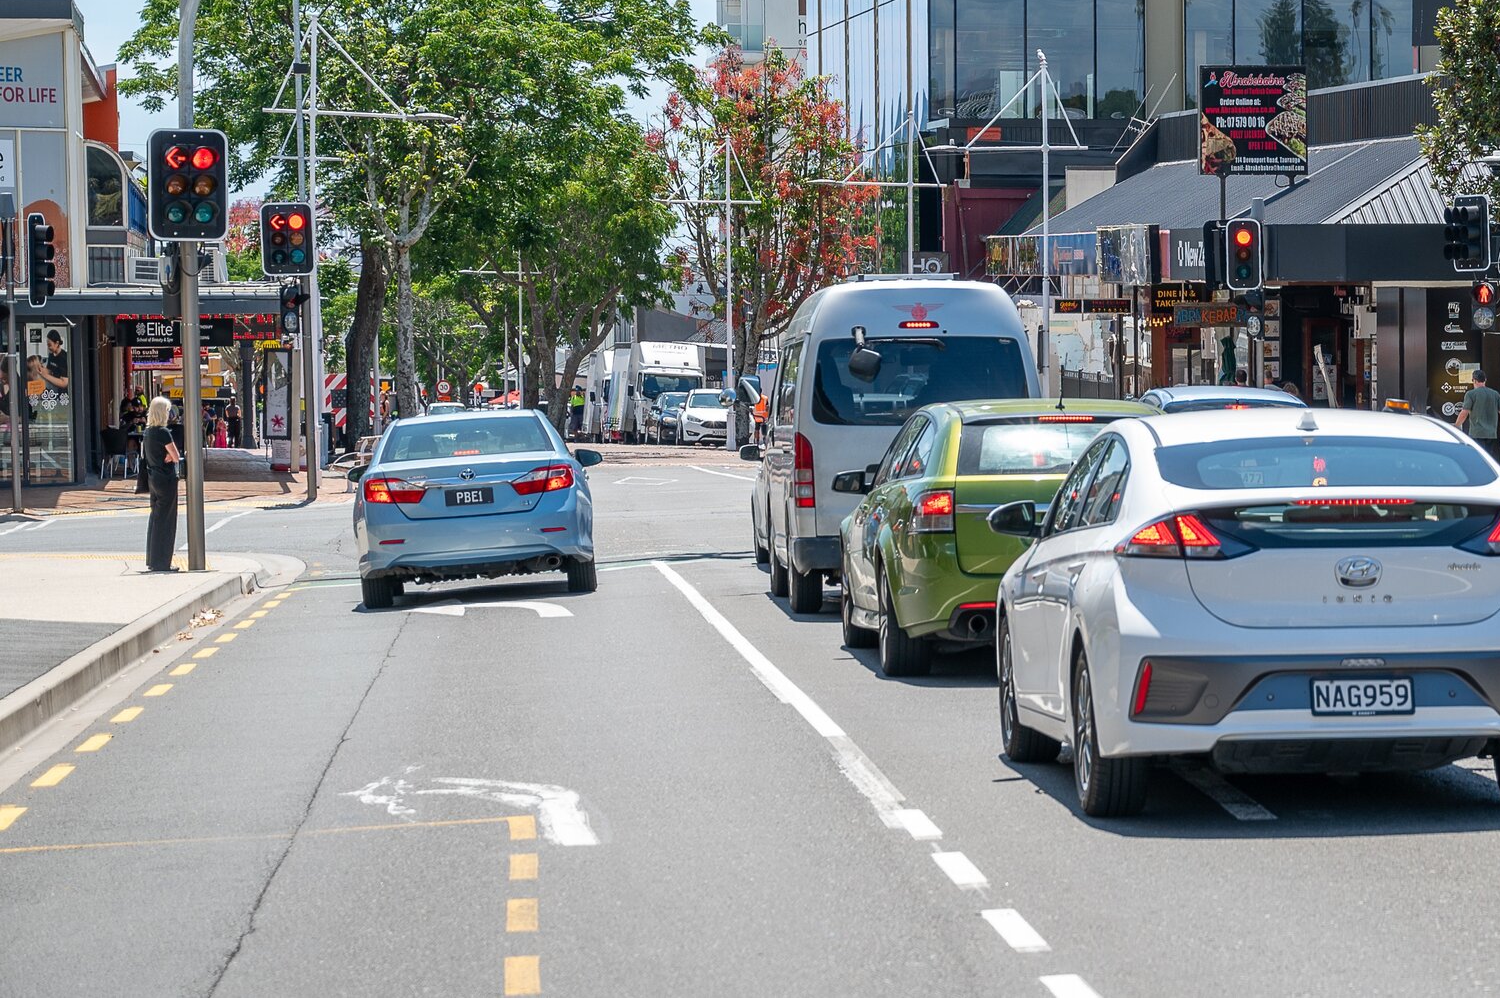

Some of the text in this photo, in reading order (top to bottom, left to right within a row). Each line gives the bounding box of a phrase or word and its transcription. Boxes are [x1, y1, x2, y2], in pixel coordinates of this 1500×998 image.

[29, 87, 56, 103] LIFE
[1220, 98, 1234, 106] Order
[1236, 98, 1253, 106] Online
[1216, 116, 1265, 128] Ph: 07 579 00 16
[1184, 242, 1198, 266] New
[1157, 290, 1177, 298] DINE
[1179, 290, 1188, 298] IN
[147, 322, 173, 336] Elite
[456, 489, 483, 504] PBE1
[1315, 684, 1409, 708] NAG959
